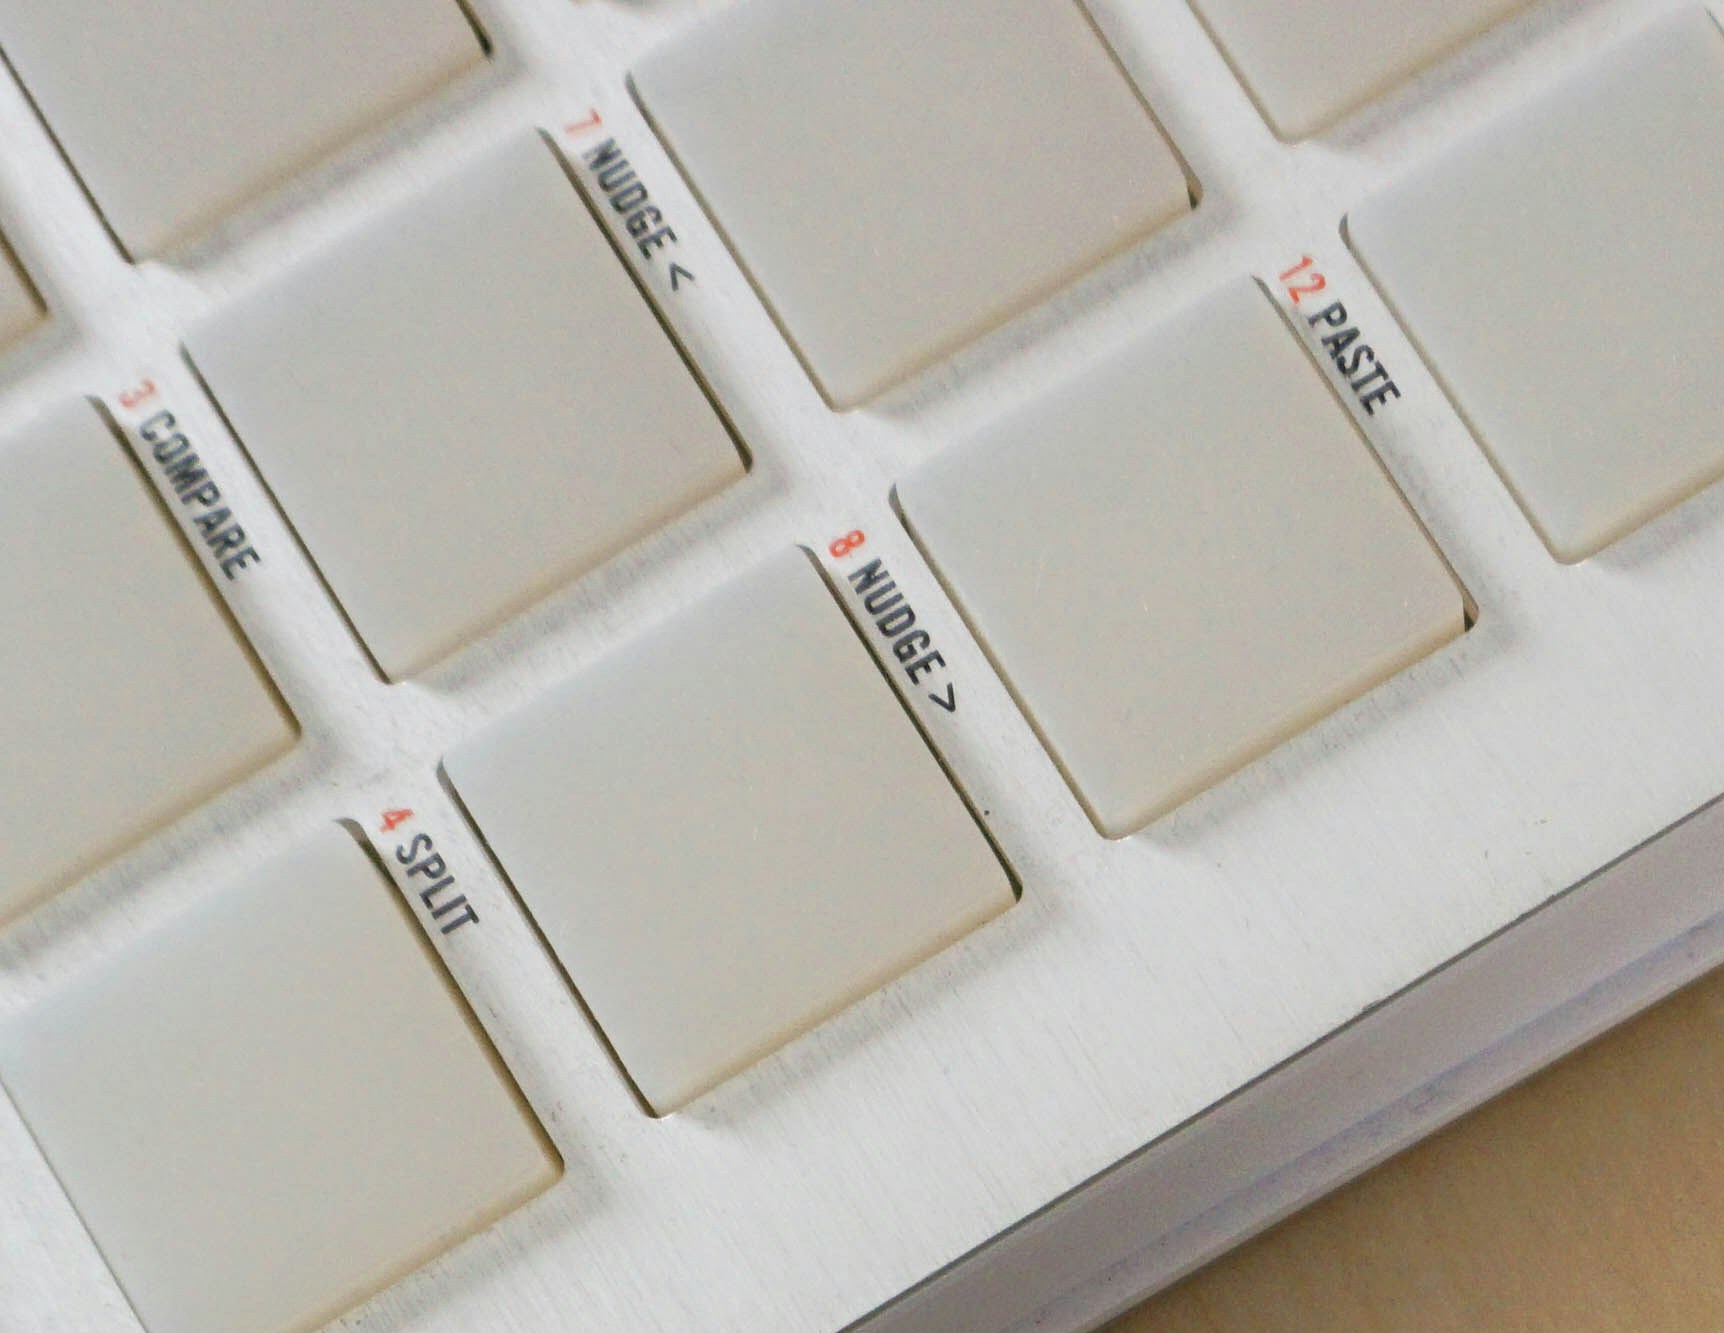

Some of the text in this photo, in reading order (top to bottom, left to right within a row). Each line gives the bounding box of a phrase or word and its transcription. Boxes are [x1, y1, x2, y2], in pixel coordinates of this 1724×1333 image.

[564, 108, 602, 135] 7
[582, 137, 677, 260] NUDGE
[1279, 254, 1402, 417] 12 PASTE
[119, 378, 262, 581] 3 COMPARE
[829, 529, 865, 558] 8
[847, 557, 947, 685] NUDGE
[380, 808, 480, 935] 4 SPLIT
